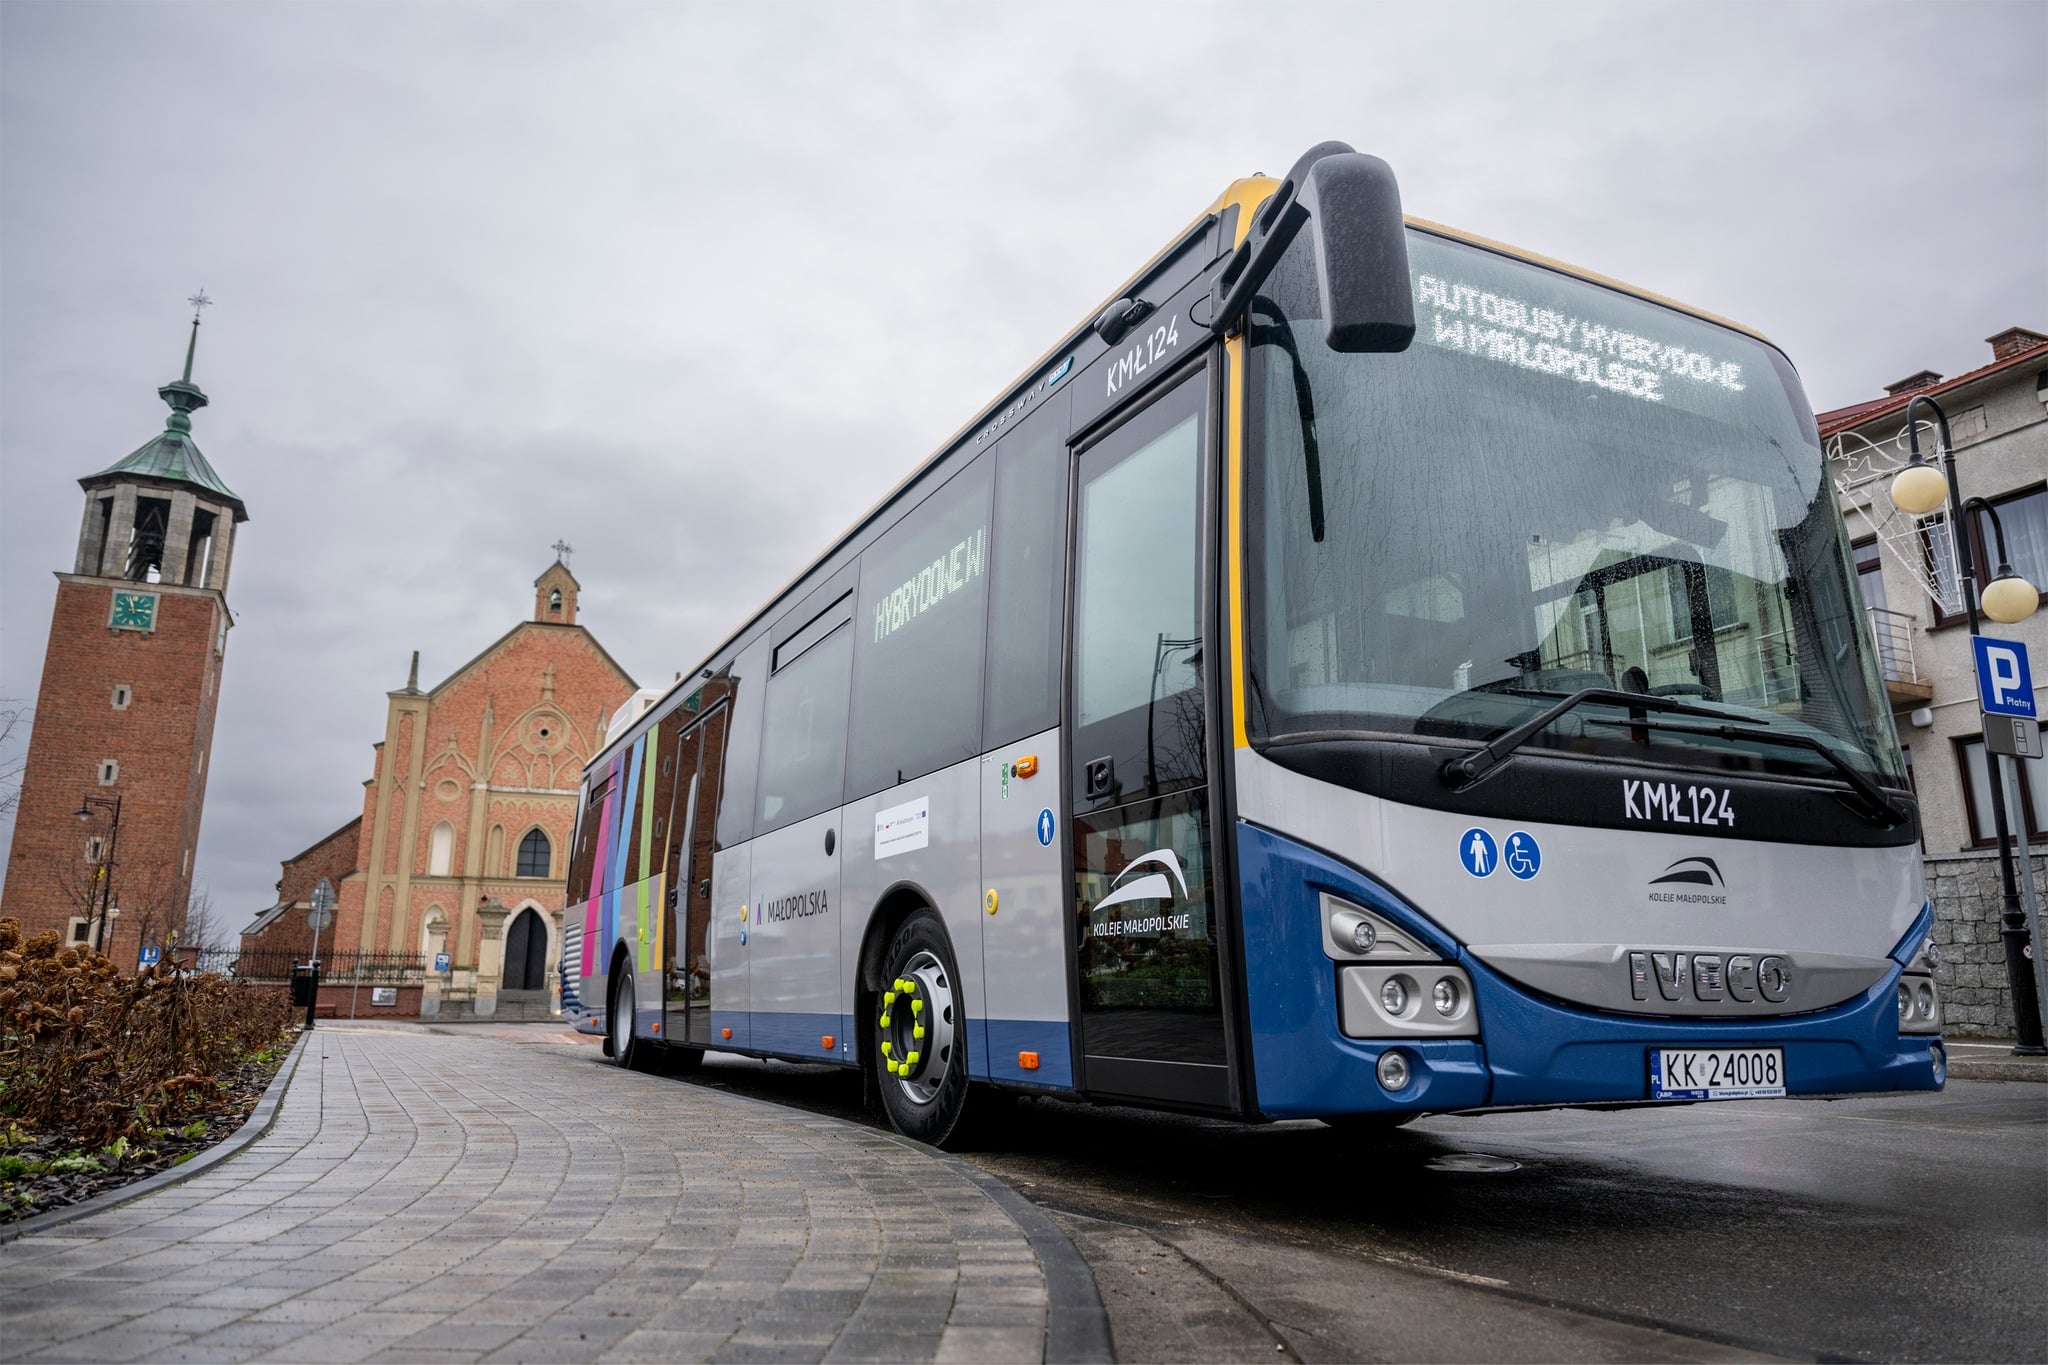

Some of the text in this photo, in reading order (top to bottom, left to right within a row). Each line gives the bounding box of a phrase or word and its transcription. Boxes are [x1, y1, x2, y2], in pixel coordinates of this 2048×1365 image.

[1418, 273, 1577, 343] AUTOBUSY
[1106, 314, 1179, 397] KMŁ124
[976, 381, 1046, 445] CROSSWAY
[1986, 645, 2021, 705] P
[1622, 779, 1735, 827] KMŁ124
[767, 889, 829, 924] MAŁOPOLSKA
[1648, 892, 1727, 905] KOLEJE MAŁOPOLSKIE
[1093, 914, 1190, 937] KOLEJE MAŁOPOLSKIE
[1629, 951, 1793, 1003] IVECO
[1651, 1074, 1661, 1085] PL
[1666, 1053, 1778, 1087] KK 24008
